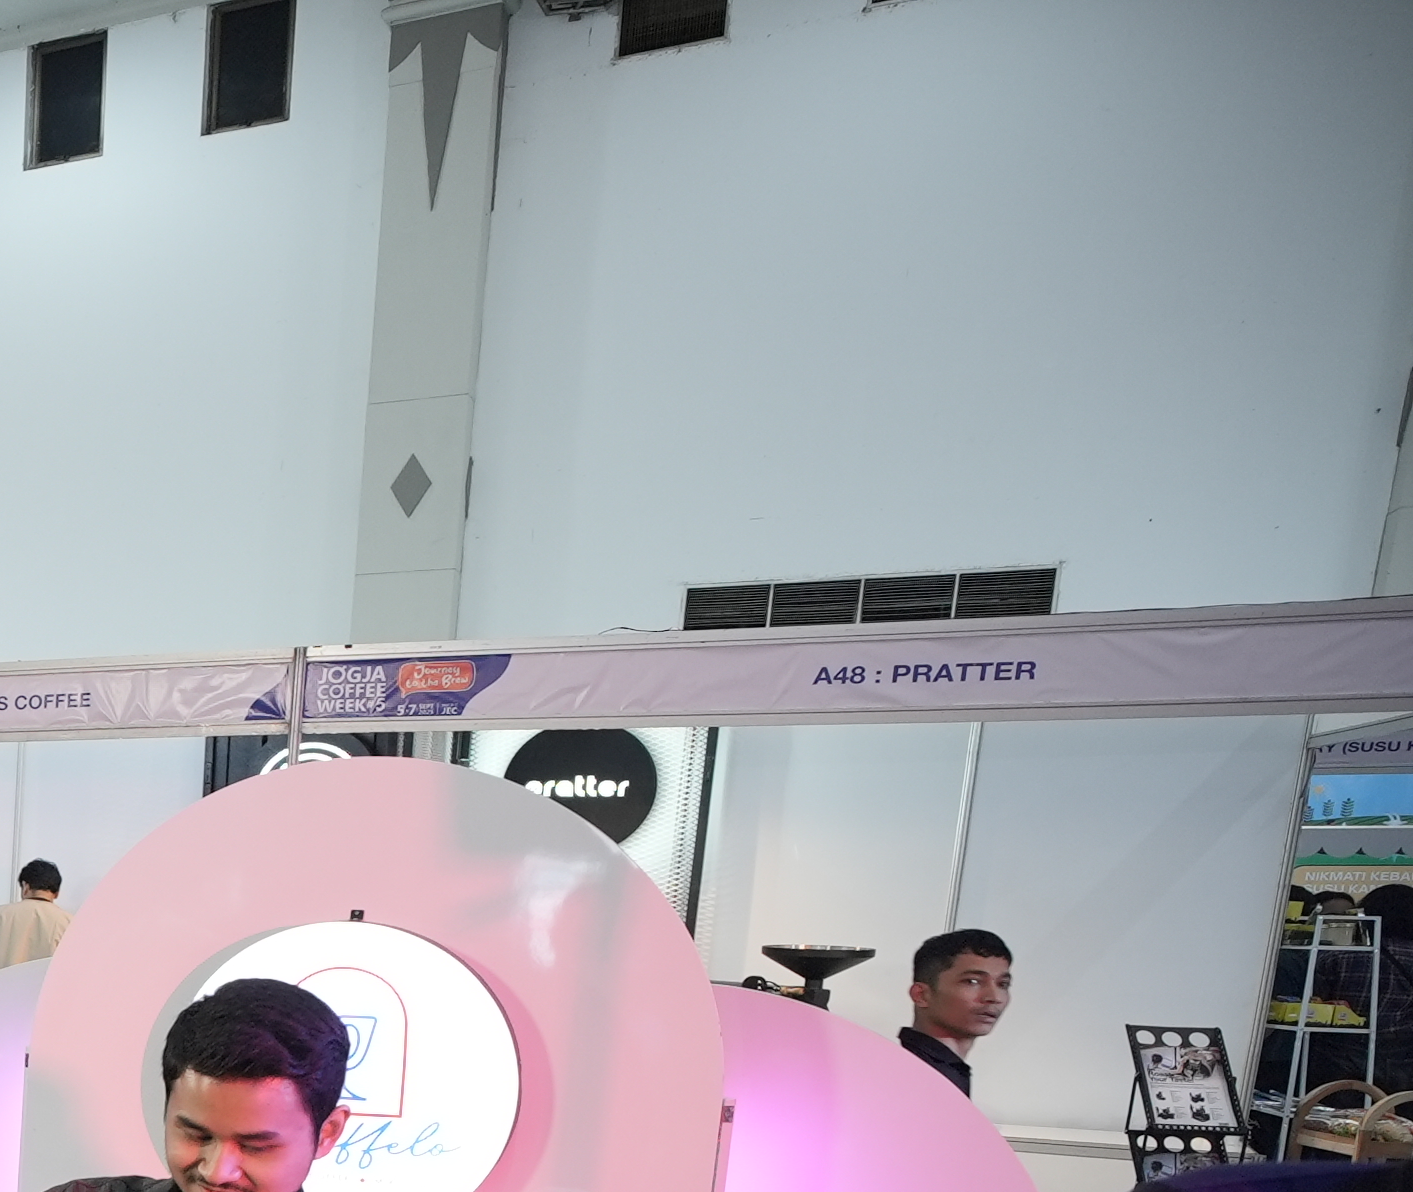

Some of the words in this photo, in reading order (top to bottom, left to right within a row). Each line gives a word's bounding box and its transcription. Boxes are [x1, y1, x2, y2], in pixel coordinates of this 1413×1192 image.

[318, 665, 386, 684] JOGJA
[413, 666, 461, 679] Journey
[442, 674, 470, 688] Brew
[812, 665, 866, 685] A48
[874, 669, 882, 683] :
[891, 661, 1037, 683] PRATTER
[317, 682, 386, 699] COFFEE
[14, 693, 91, 710] COFFEE
[1342, 740, 1401, 755] (SUSU
[1304, 871, 1366, 881] NIKMATI
[333, 1120, 461, 1169] ffelo
